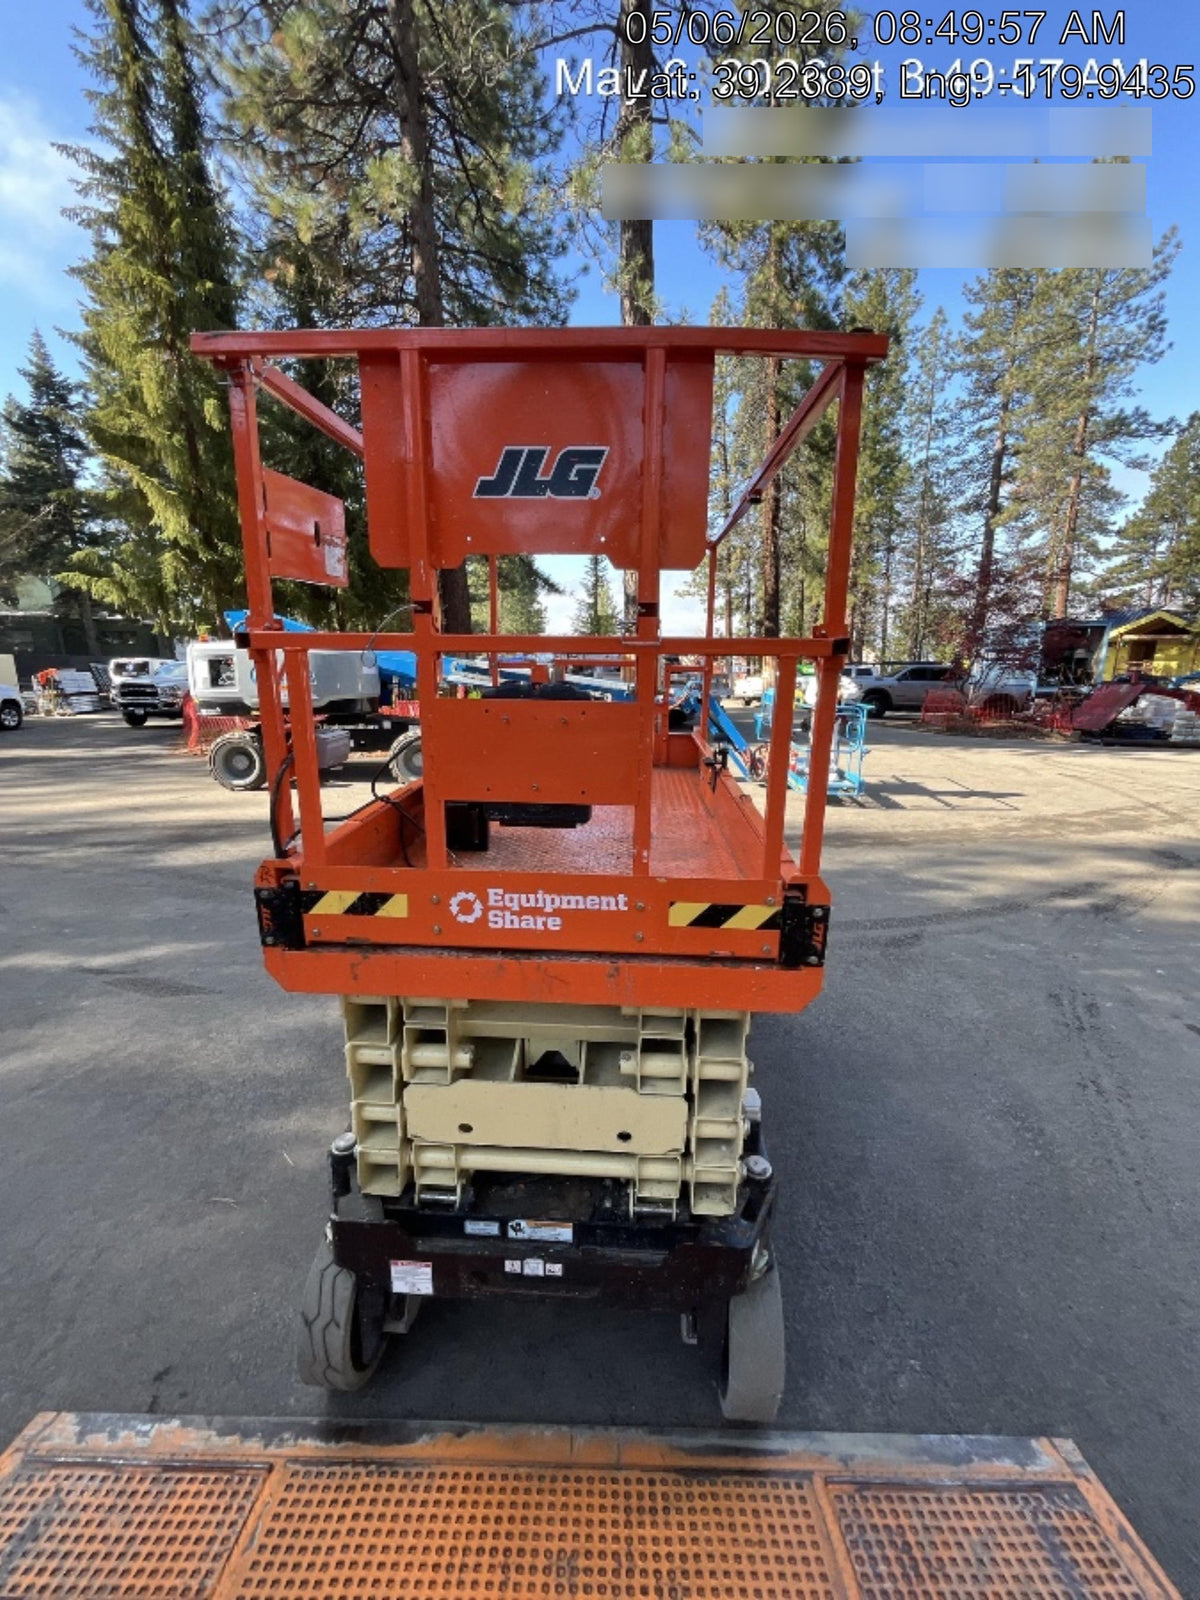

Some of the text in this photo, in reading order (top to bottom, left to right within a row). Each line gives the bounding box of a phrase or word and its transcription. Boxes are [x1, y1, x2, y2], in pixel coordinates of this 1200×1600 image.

[472, 445, 609, 500] JLG
[486, 888, 628, 912] Equipment
[488, 910, 562, 931] Share
